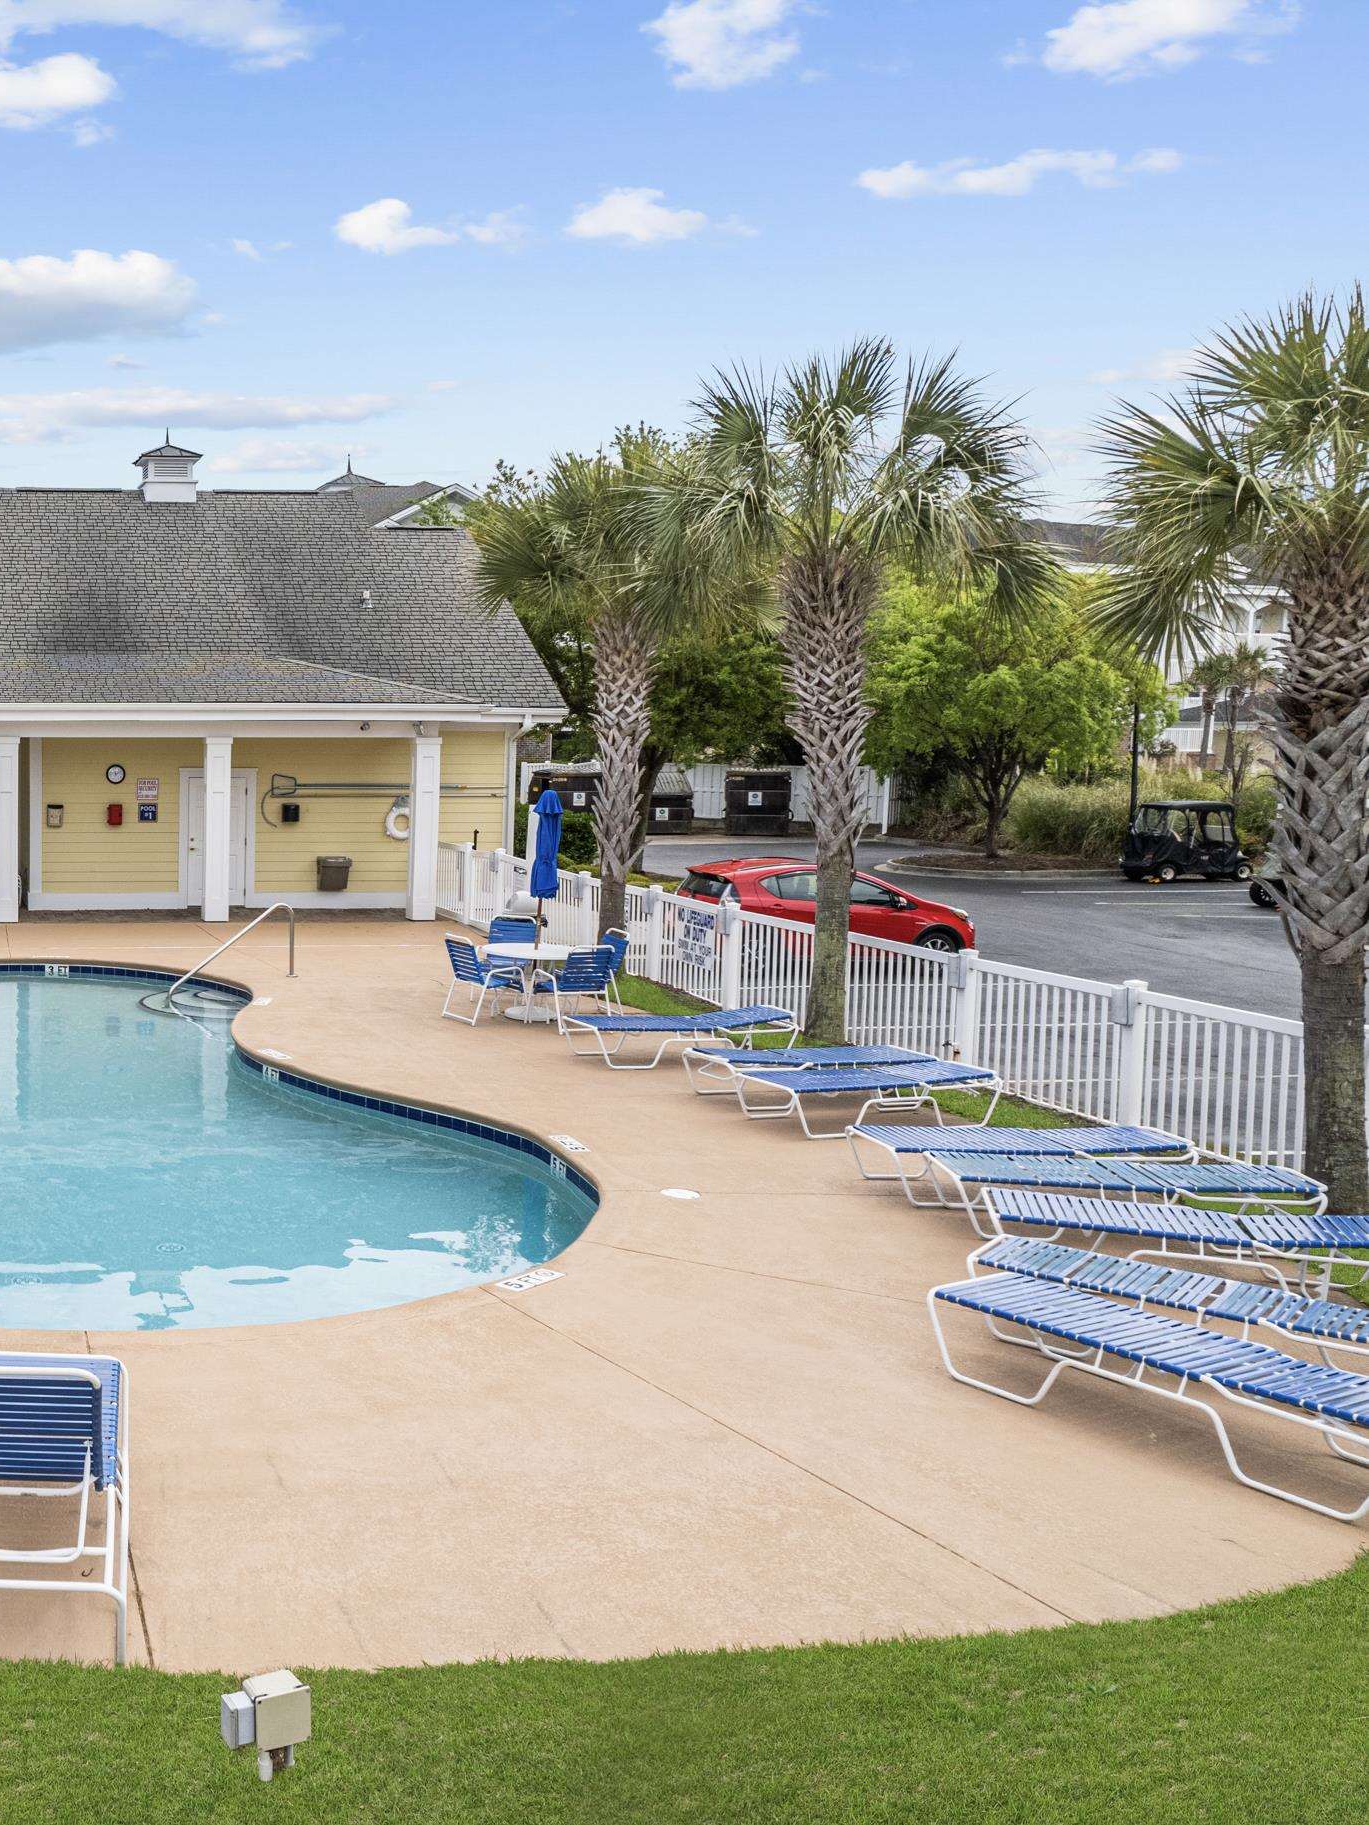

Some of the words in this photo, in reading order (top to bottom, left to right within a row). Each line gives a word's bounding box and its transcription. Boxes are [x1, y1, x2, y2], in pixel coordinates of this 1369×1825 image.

[678, 907, 685, 922] NO
[687, 909, 714, 930] LIFEGUARD
[684, 924, 691, 939] ON
[692, 926, 707, 944] DUTY
[678, 938, 689, 951] SWIM
[690, 942, 697, 953] AT
[698, 944, 711, 958] YOUR
[503, 1281, 523, 1289] 5
[517, 1274, 542, 1284] FT
